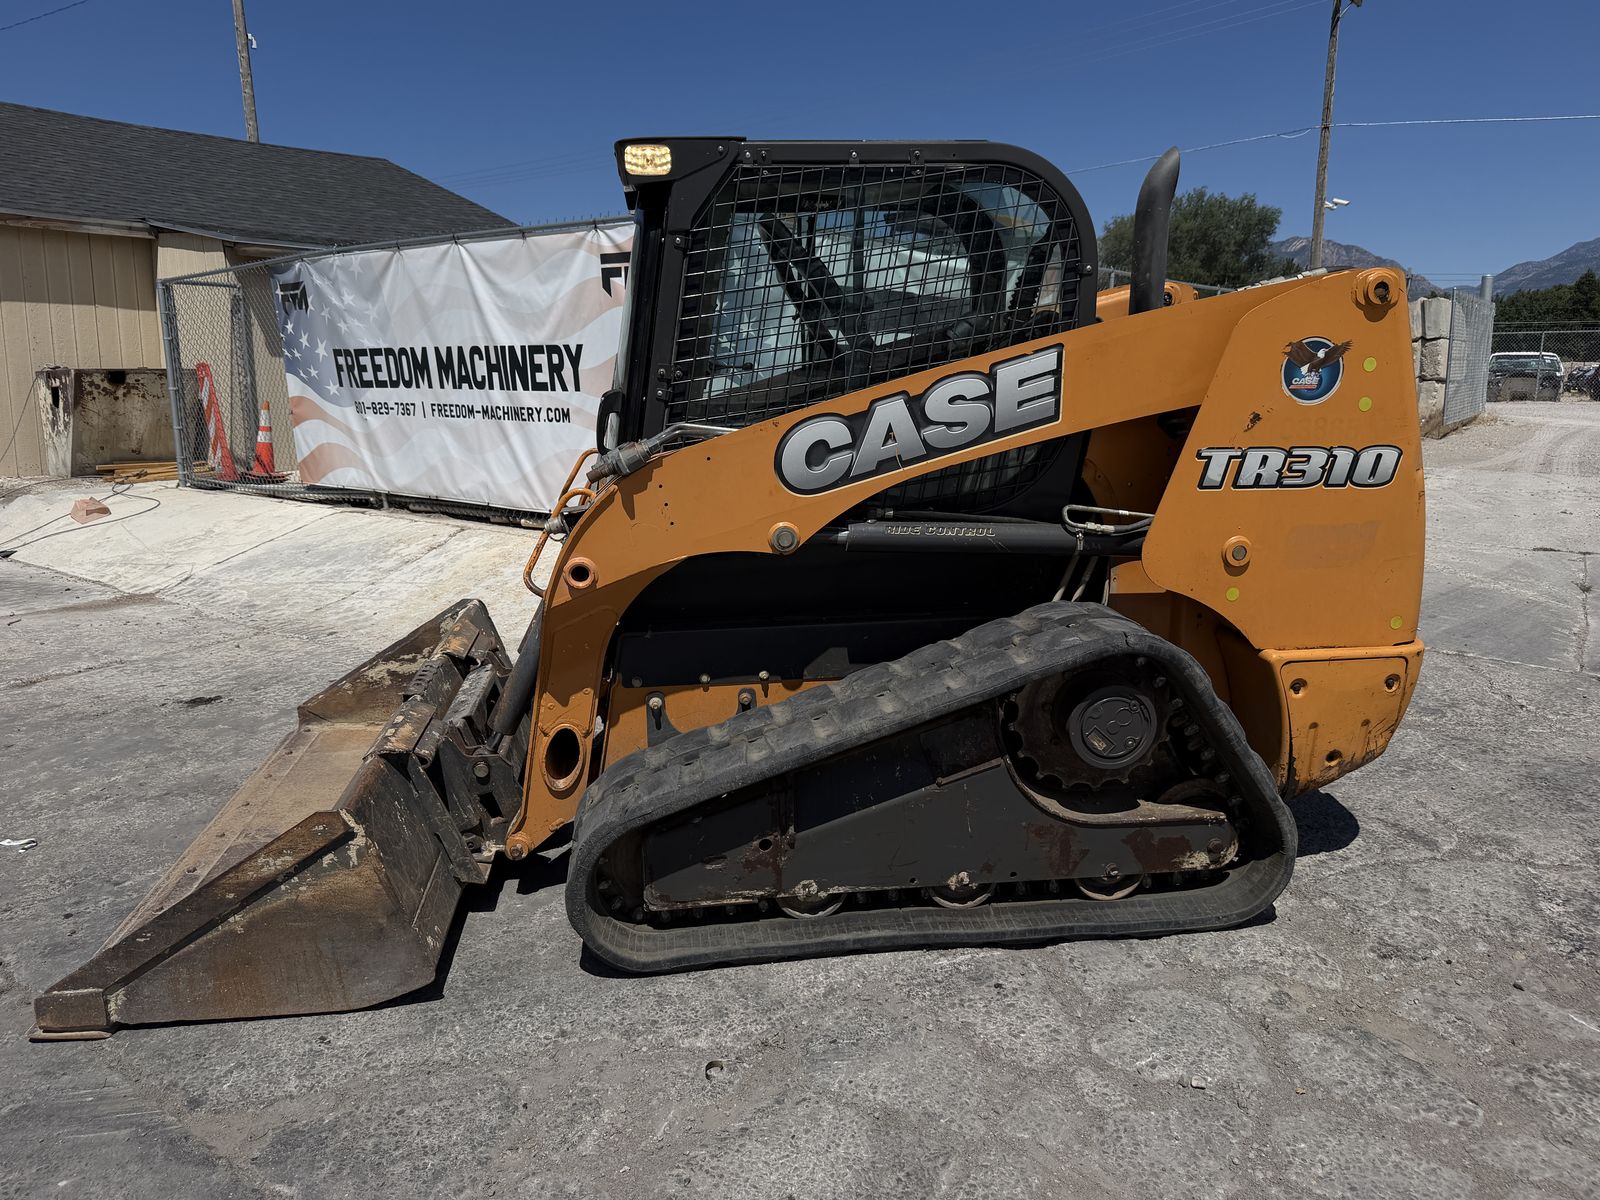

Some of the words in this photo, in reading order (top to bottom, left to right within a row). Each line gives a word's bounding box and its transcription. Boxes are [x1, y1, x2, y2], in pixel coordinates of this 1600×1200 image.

[332, 346, 432, 390] FREEDOM
[434, 343, 584, 393] MACHINERY
[1291, 375, 1320, 385] CASE
[431, 402, 571, 424] FREEDOM-MACHINERY.COM
[778, 347, 1061, 493] CASE
[1196, 445, 1403, 490] TR310
[884, 525, 921, 536] RIDE
[925, 525, 997, 537] CONTROL
